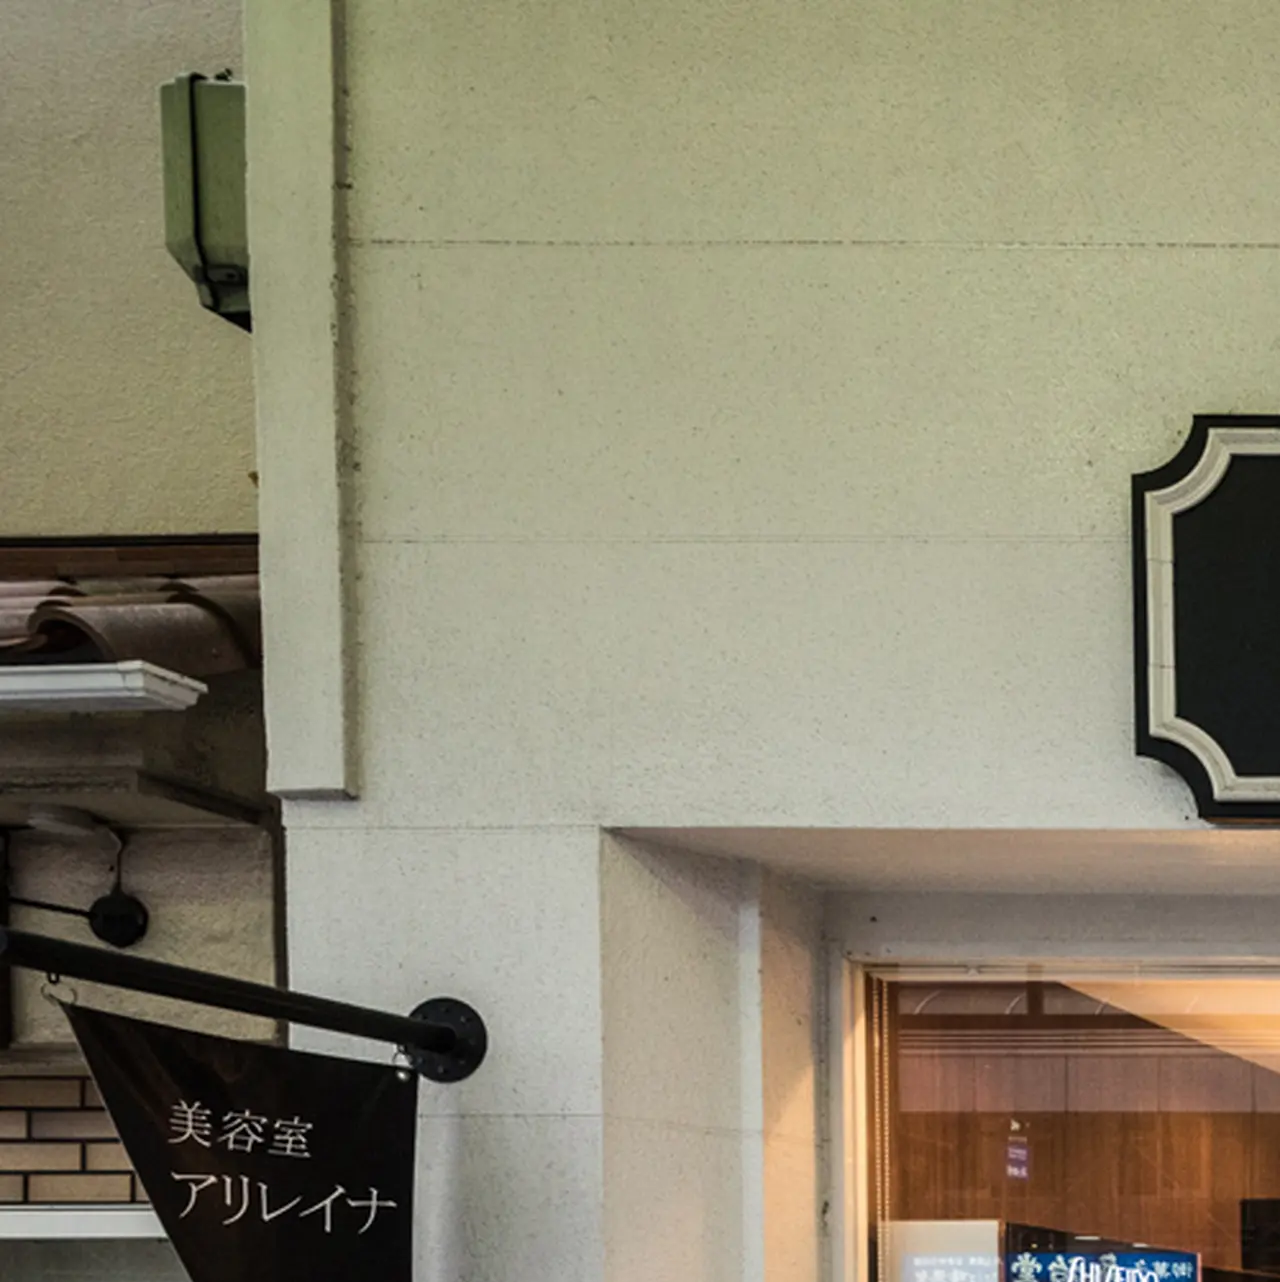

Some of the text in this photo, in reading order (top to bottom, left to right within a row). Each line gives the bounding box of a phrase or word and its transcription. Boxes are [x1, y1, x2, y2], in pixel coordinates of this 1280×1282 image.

[168, 1099, 313, 1158] 美容室
[170, 1171, 398, 1235] アリレイナ
